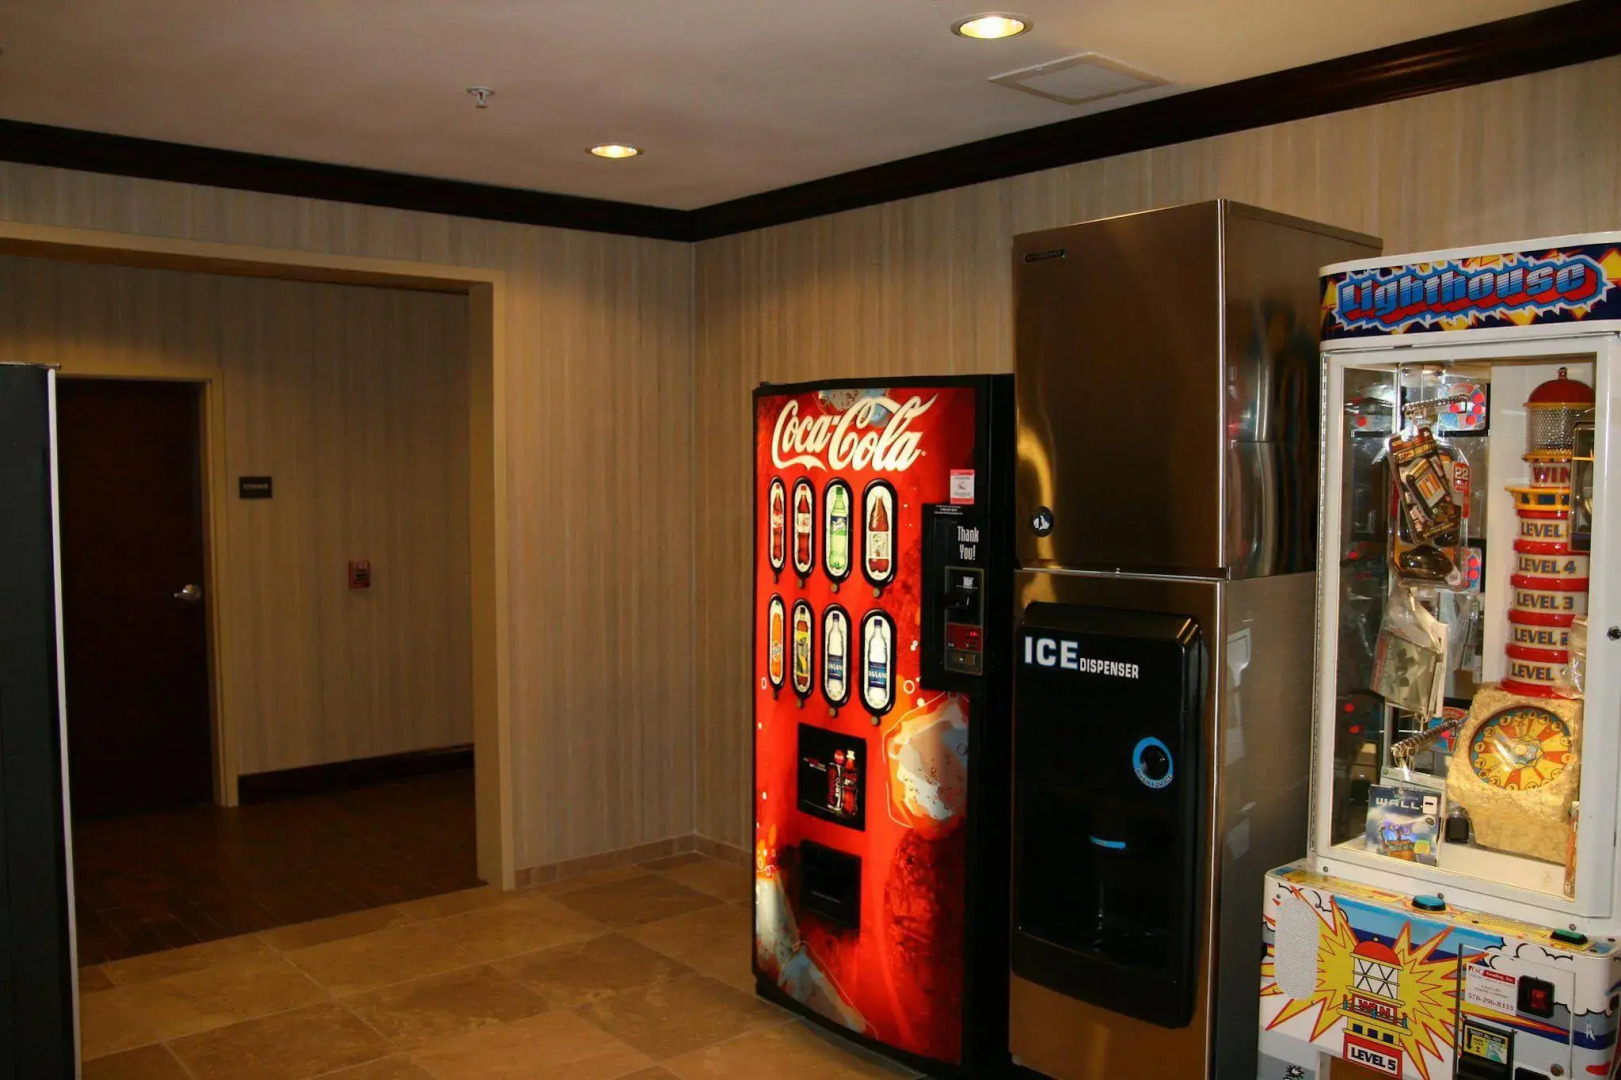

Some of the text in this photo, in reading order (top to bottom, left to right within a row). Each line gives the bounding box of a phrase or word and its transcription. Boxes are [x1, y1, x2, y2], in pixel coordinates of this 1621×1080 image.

[1341, 263, 1586, 317] Lighthouse
[771, 393, 938, 471] Coca-Cola
[957, 525, 979, 543] Thank
[1520, 522, 1563, 538] LEVEL
[959, 543, 976, 560] You!
[1519, 557, 1576, 574] LEVEL 4
[1516, 591, 1574, 610] LEVEL 3
[1514, 627, 1556, 646] LEVEL
[1024, 635, 1139, 679] ICE DISPENSER
[1512, 662, 1555, 681] LEVEL
[1351, 1047, 1397, 1071] LEVEL 5
